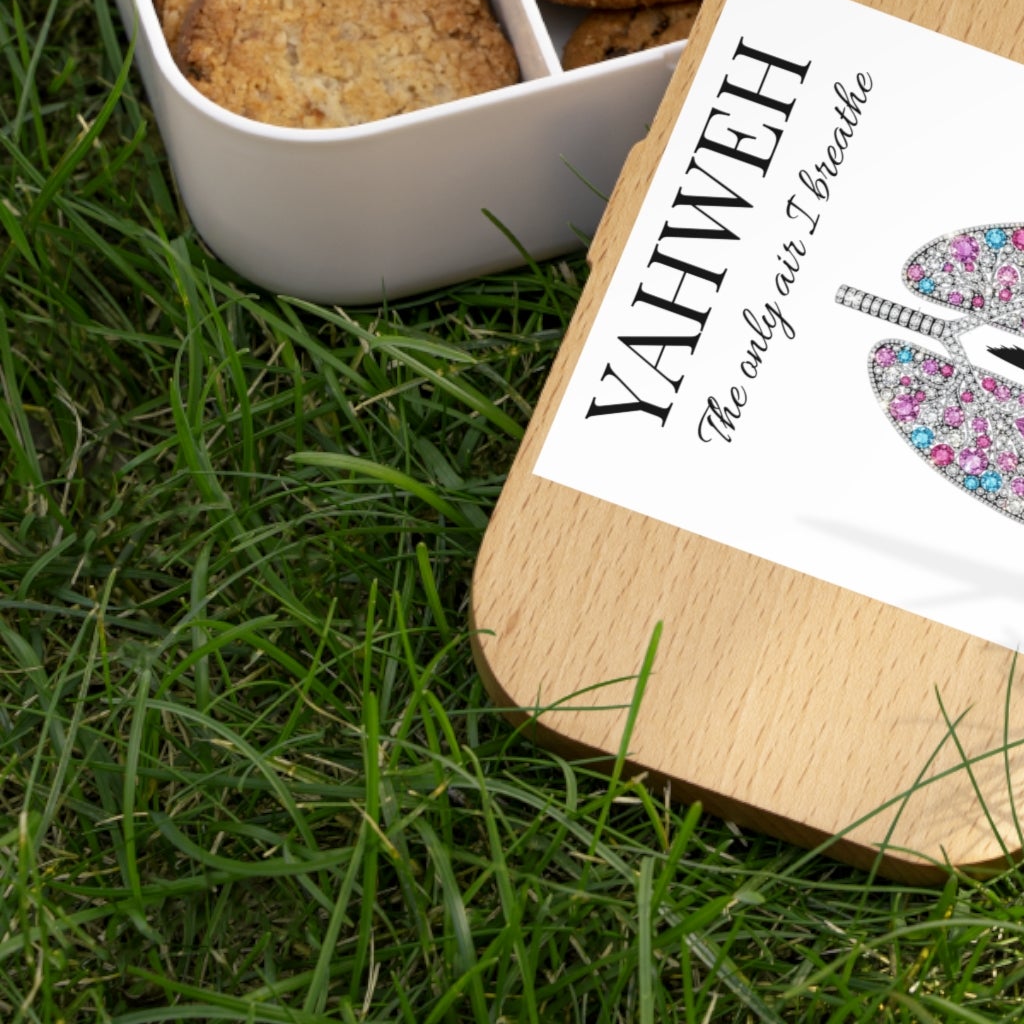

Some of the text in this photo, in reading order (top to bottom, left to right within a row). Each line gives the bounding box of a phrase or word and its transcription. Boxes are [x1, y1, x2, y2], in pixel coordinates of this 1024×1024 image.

[585, 36, 812, 428] YAHWEH
[697, 71, 873, 444] The only air I breathe
